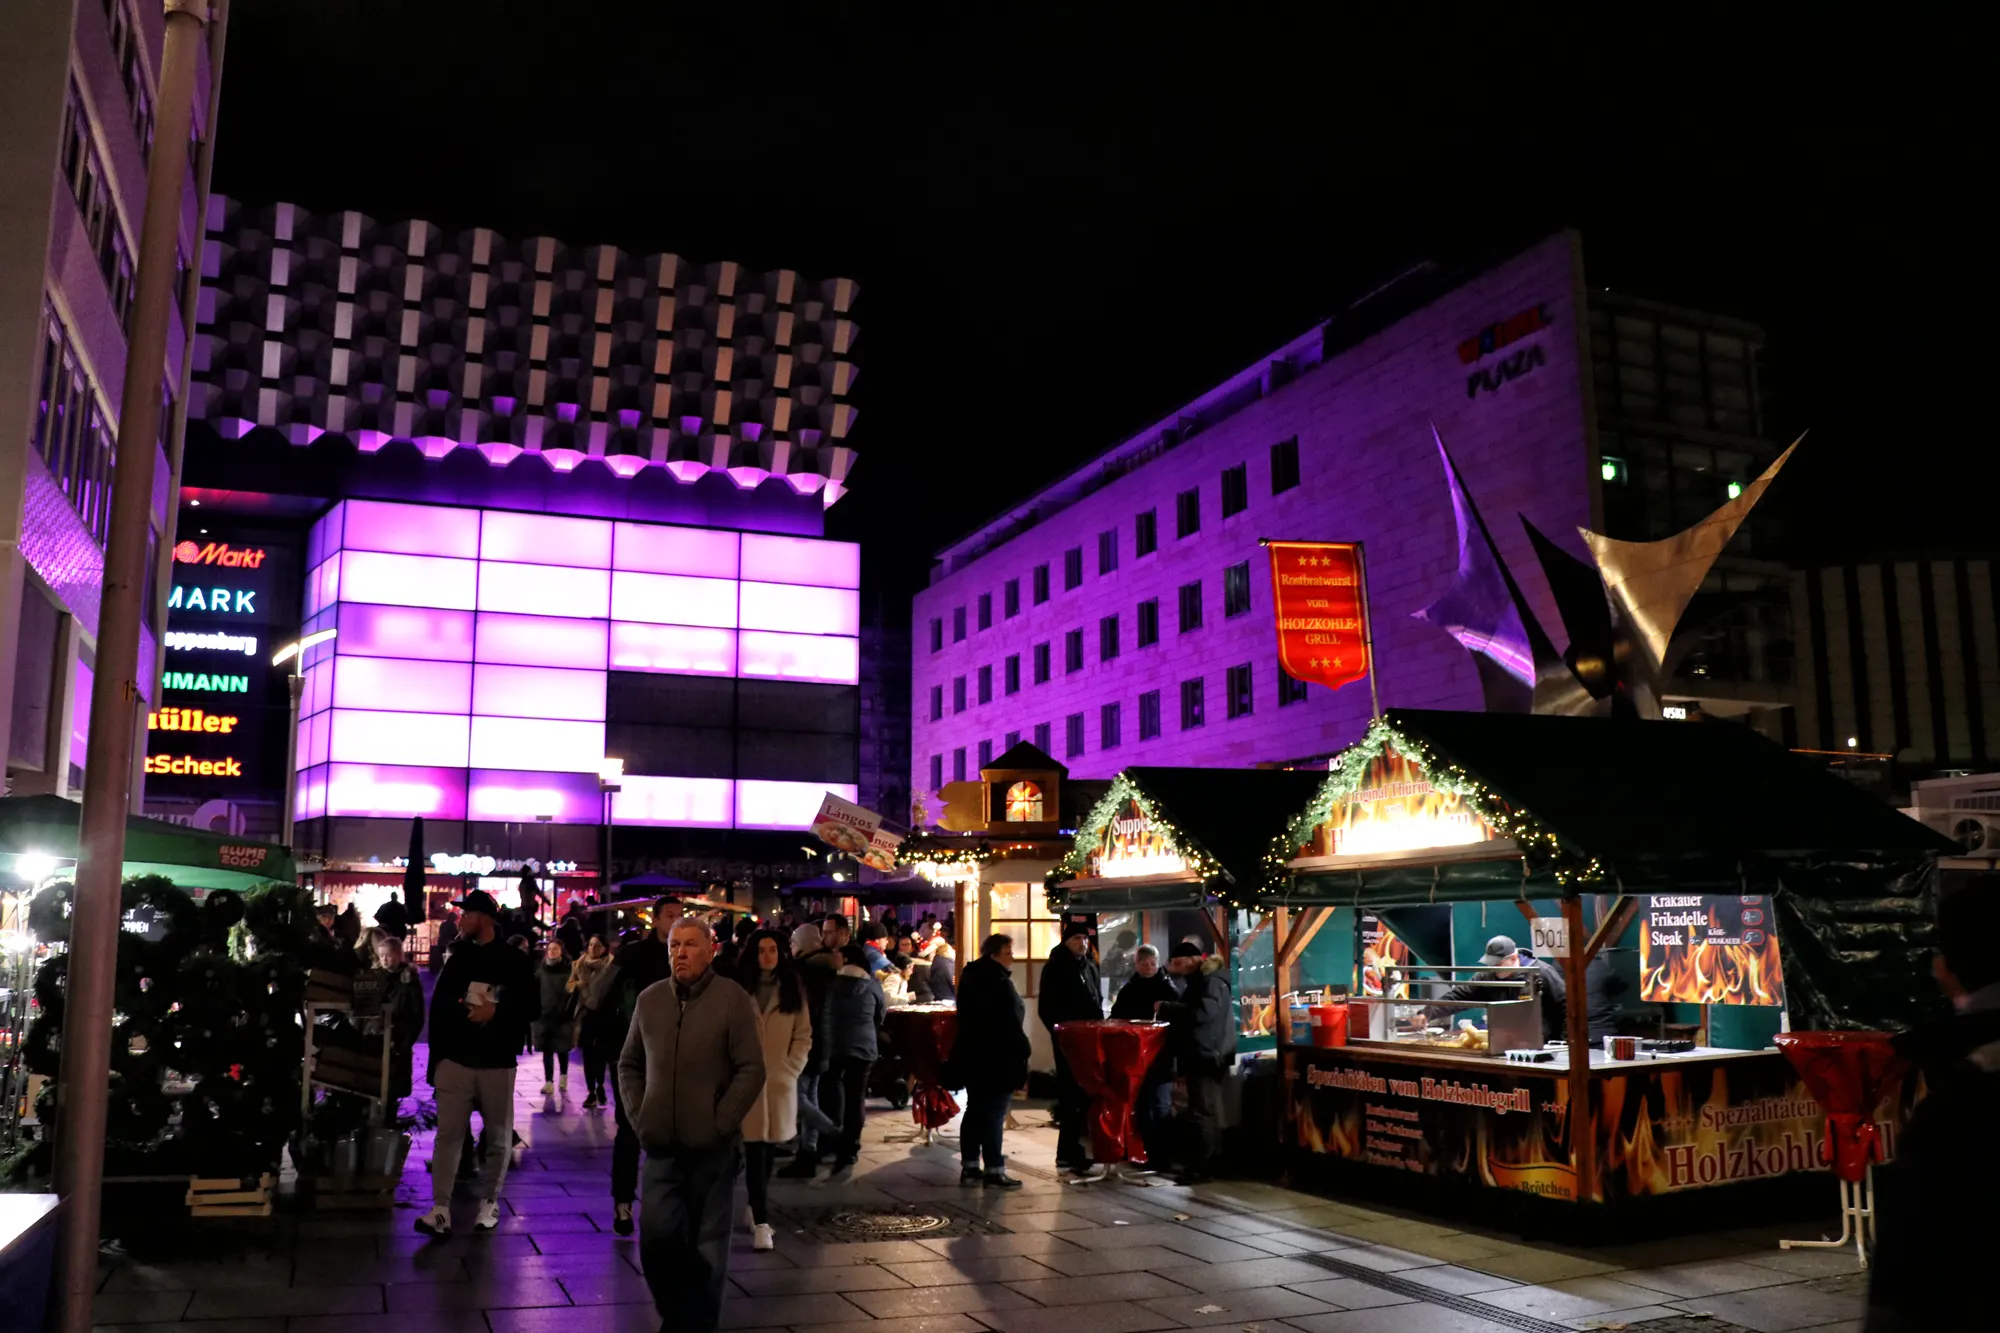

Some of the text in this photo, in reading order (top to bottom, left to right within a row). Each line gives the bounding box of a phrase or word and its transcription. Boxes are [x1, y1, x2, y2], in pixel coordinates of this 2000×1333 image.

[1467, 343, 1546, 398] PLAZA
[193, 542, 267, 568] Markt
[1281, 574, 1352, 586] Rostbratwurst
[1306, 599, 1329, 608] vom
[1284, 618, 1358, 630] HOLZKOHLE-
[1305, 634, 1341, 644] GRILL
[825, 804, 873, 829] Lángos
[220, 845, 267, 860] BLUME
[220, 855, 261, 867] 2000
[1650, 896, 1702, 908] Krakauer
[1651, 911, 1708, 926] Frikadelle
[1652, 931, 1684, 946] Steak
[1306, 1063, 1388, 1094] Spezialitäten
[1388, 1078, 1420, 1098] vom
[1421, 1077, 1531, 1115] Holzkohlegrill
[1702, 1098, 1816, 1131] Spezialitäten
[1521, 1180, 1571, 1197] Brötchen
